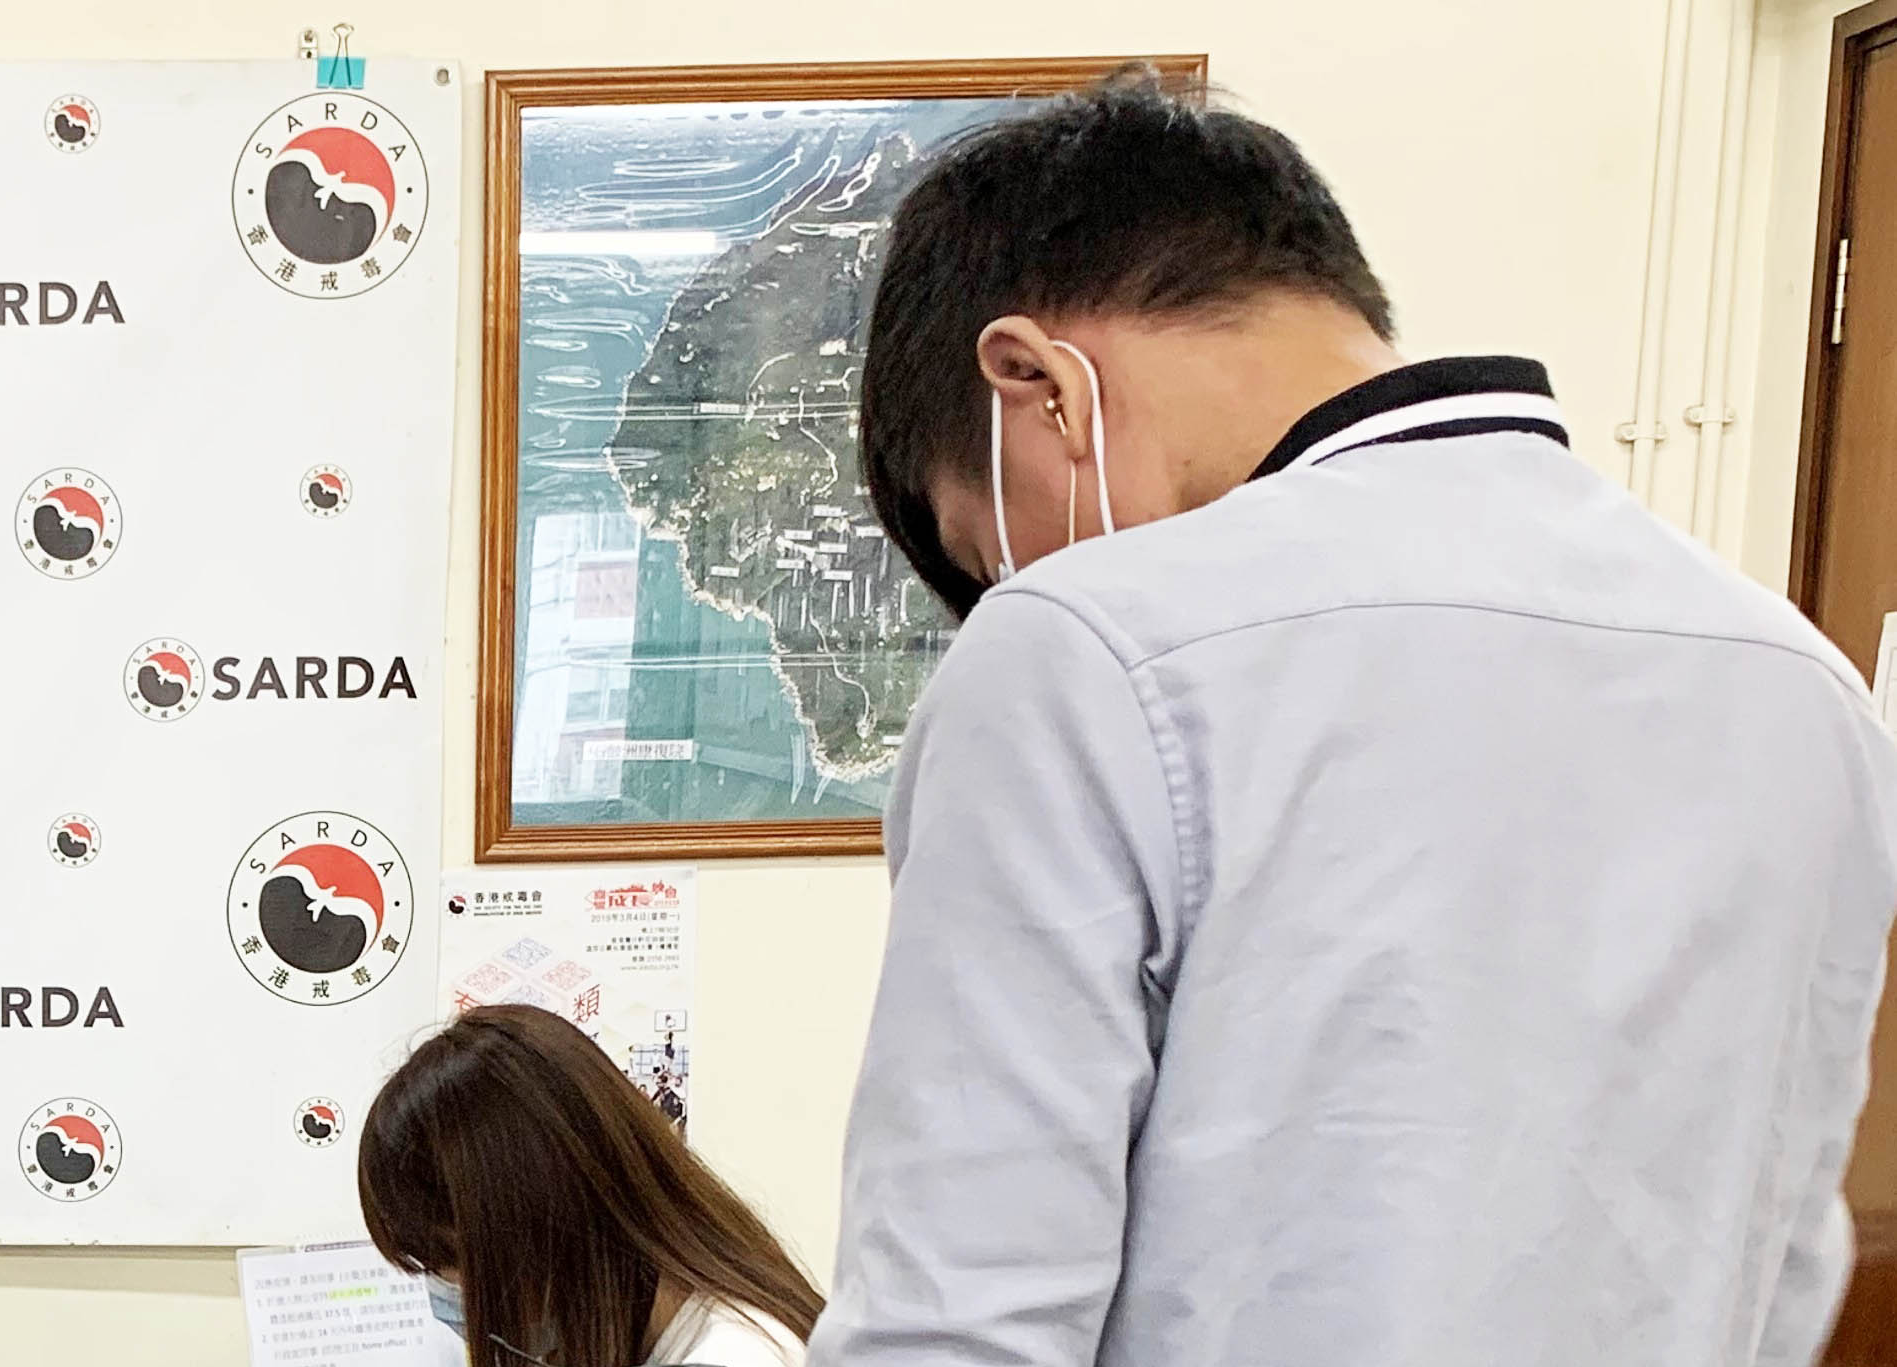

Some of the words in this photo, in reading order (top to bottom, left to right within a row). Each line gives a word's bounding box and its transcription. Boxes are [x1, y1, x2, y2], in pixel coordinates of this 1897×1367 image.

[255, 102, 406, 162] SARDA
[246, 223, 413, 291] 香港戒毒會
[27, 473, 110, 506] SARDA
[213, 657, 417, 700] SARDA
[249, 821, 395, 878] SARDA
[241, 933, 400, 999] 香港戒毒會
[30, 1102, 111, 1134] SARDA
